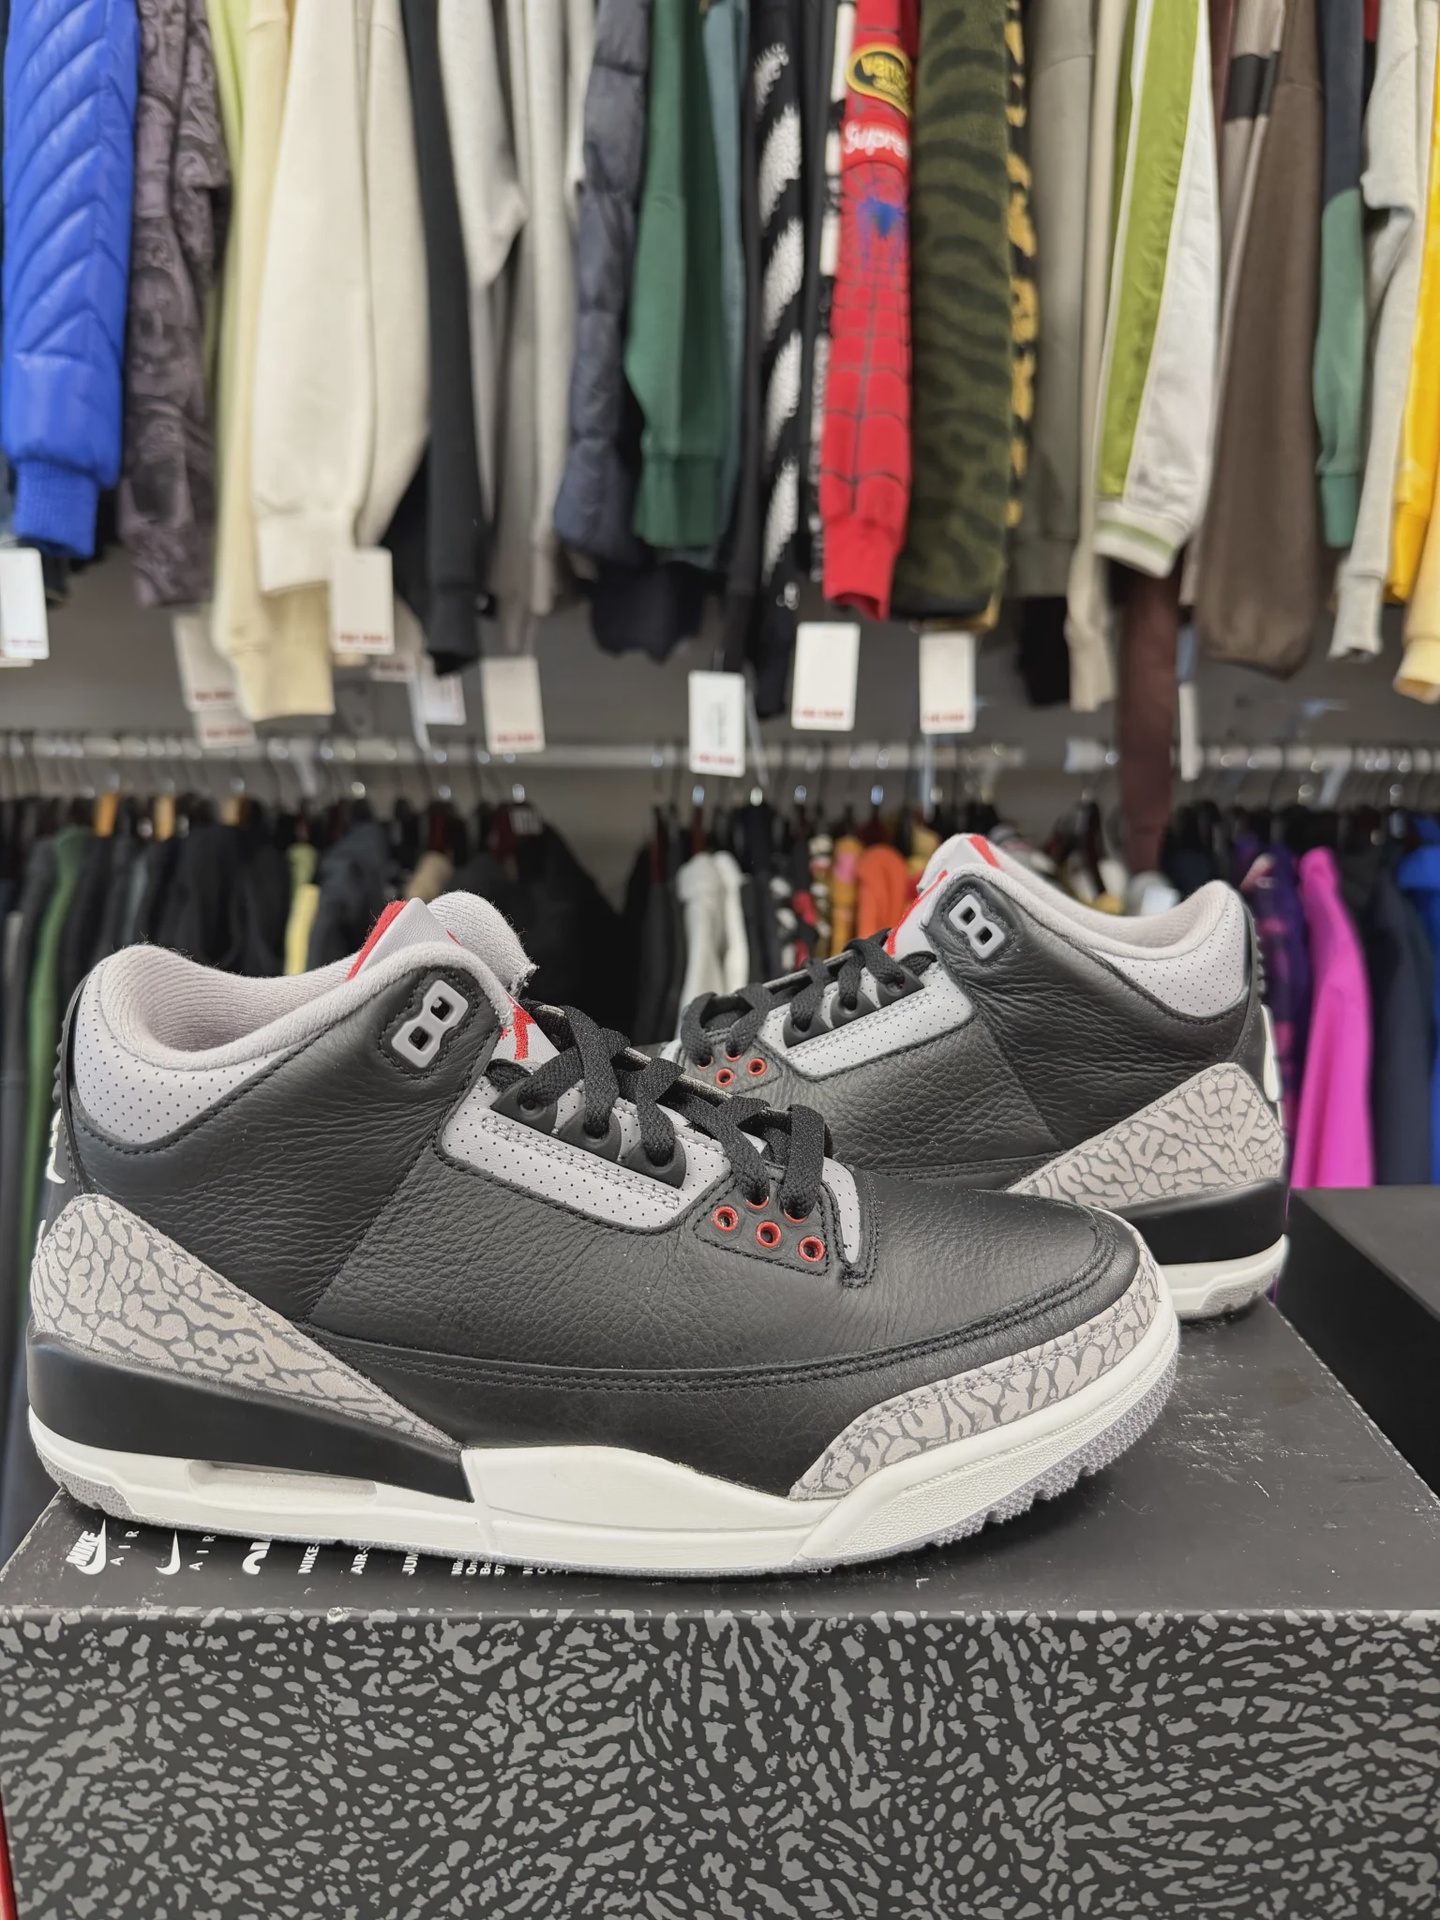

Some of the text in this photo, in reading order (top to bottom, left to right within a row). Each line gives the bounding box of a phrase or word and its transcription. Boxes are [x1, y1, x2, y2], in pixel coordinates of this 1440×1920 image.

[844, 121, 908, 157] Supre
[65, 1530, 101, 1567] NIKE
[110, 1530, 140, 1566] AIR
[189, 1535, 216, 1571] AIR
[298, 1543, 320, 1574] NIKE-
